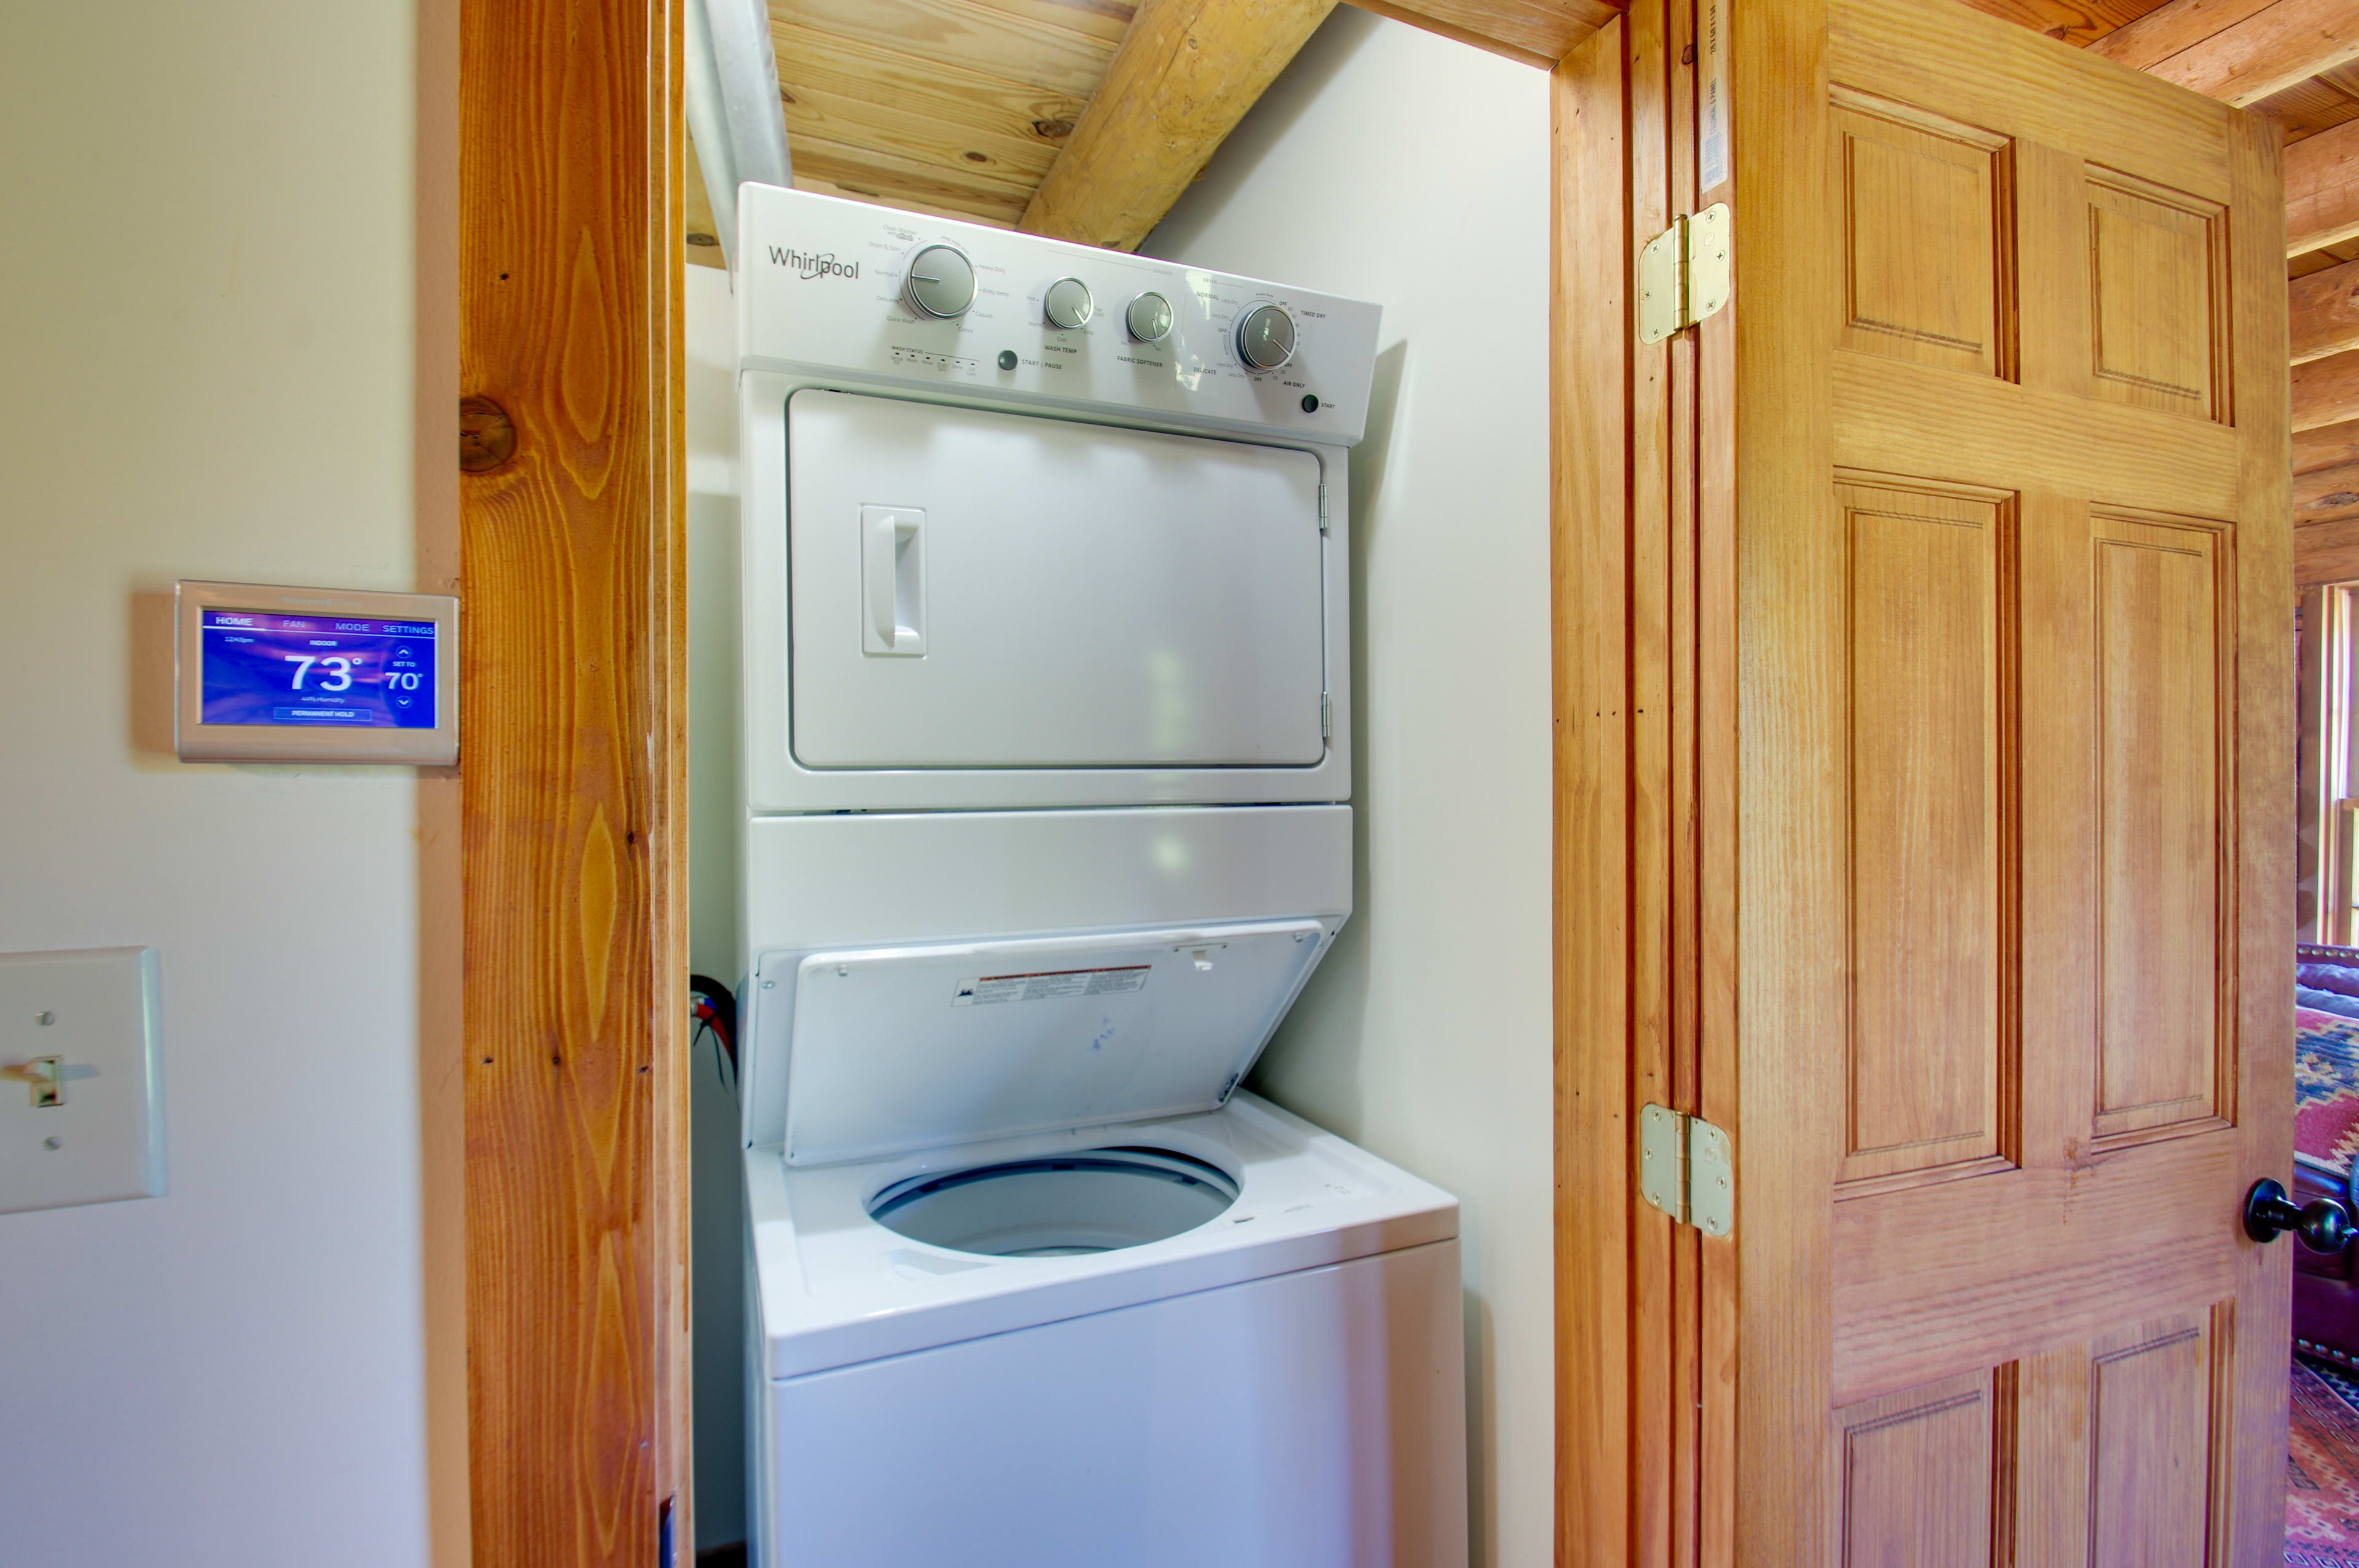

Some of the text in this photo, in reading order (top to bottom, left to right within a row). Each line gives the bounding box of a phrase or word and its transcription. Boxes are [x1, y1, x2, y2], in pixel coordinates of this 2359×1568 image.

[769, 246, 859, 279] Whirlpool
[1136, 359, 1163, 367] SOFTENER
[216, 617, 253, 626] HOME
[335, 623, 370, 631] MODE
[382, 625, 434, 634] SETTINGS
